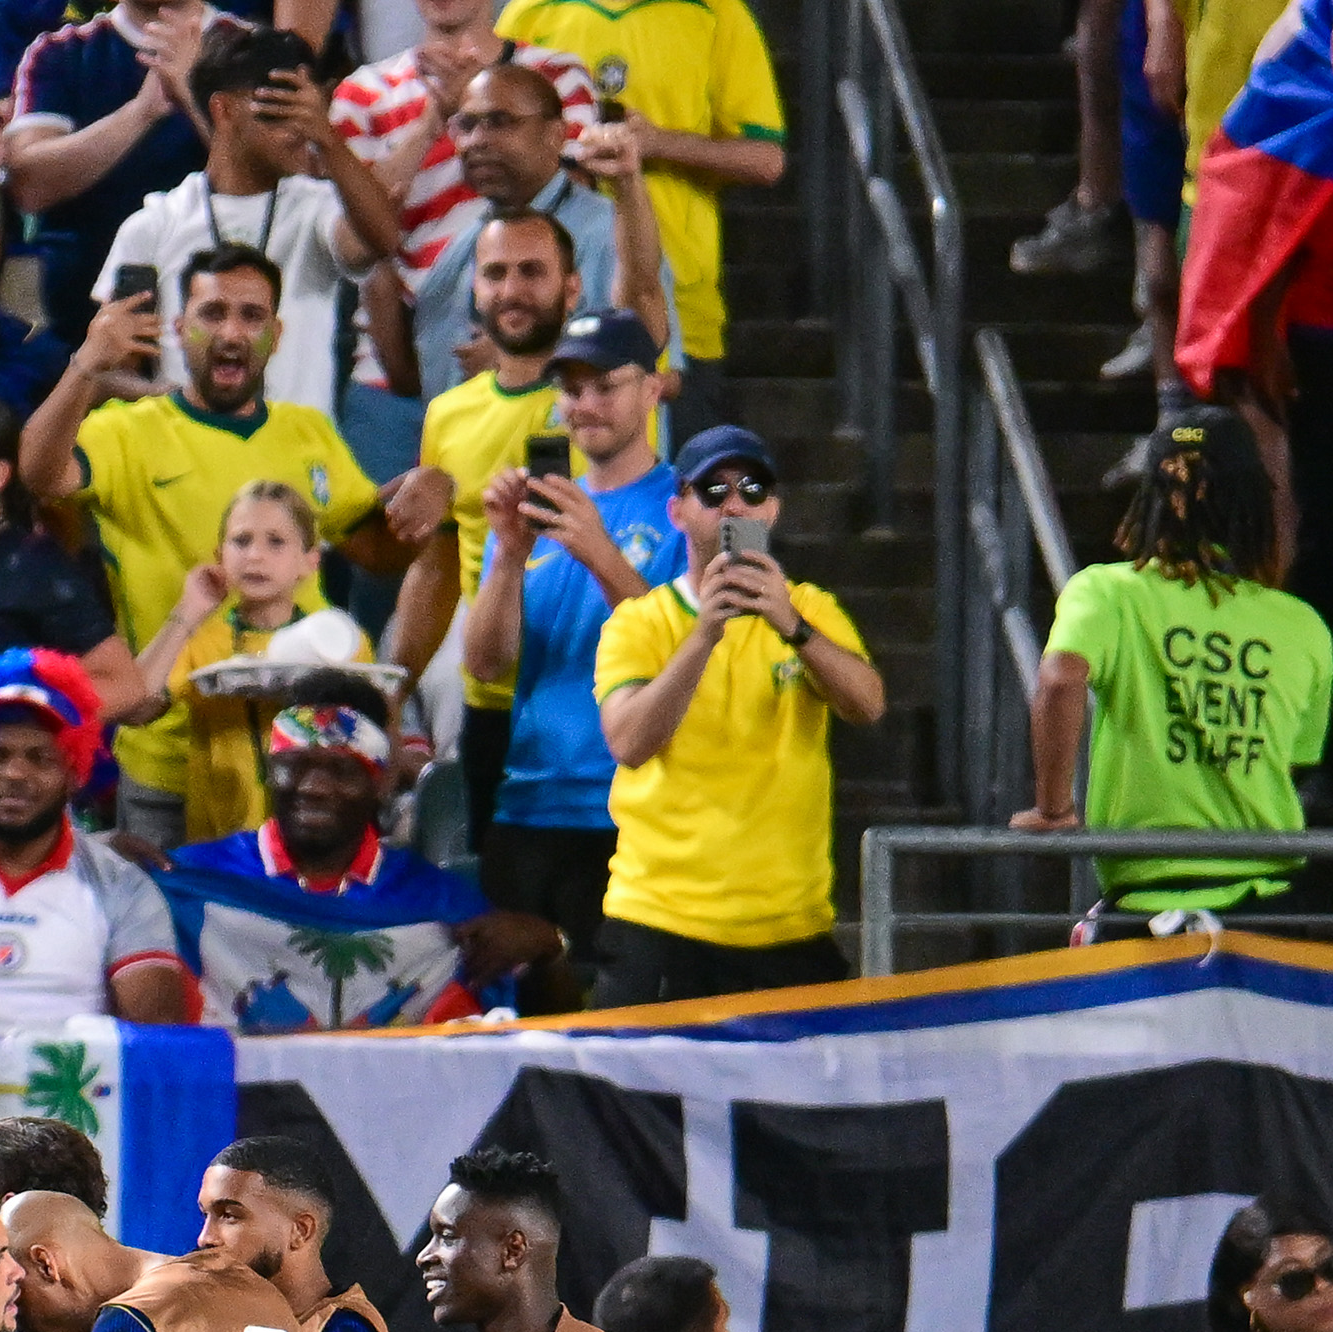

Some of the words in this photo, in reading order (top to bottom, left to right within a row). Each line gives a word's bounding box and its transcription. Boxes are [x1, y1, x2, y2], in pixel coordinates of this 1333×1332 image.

[1162, 624, 1273, 681] CSC
[1166, 675, 1267, 730] EVENT
[1165, 719, 1266, 777] STAFF
